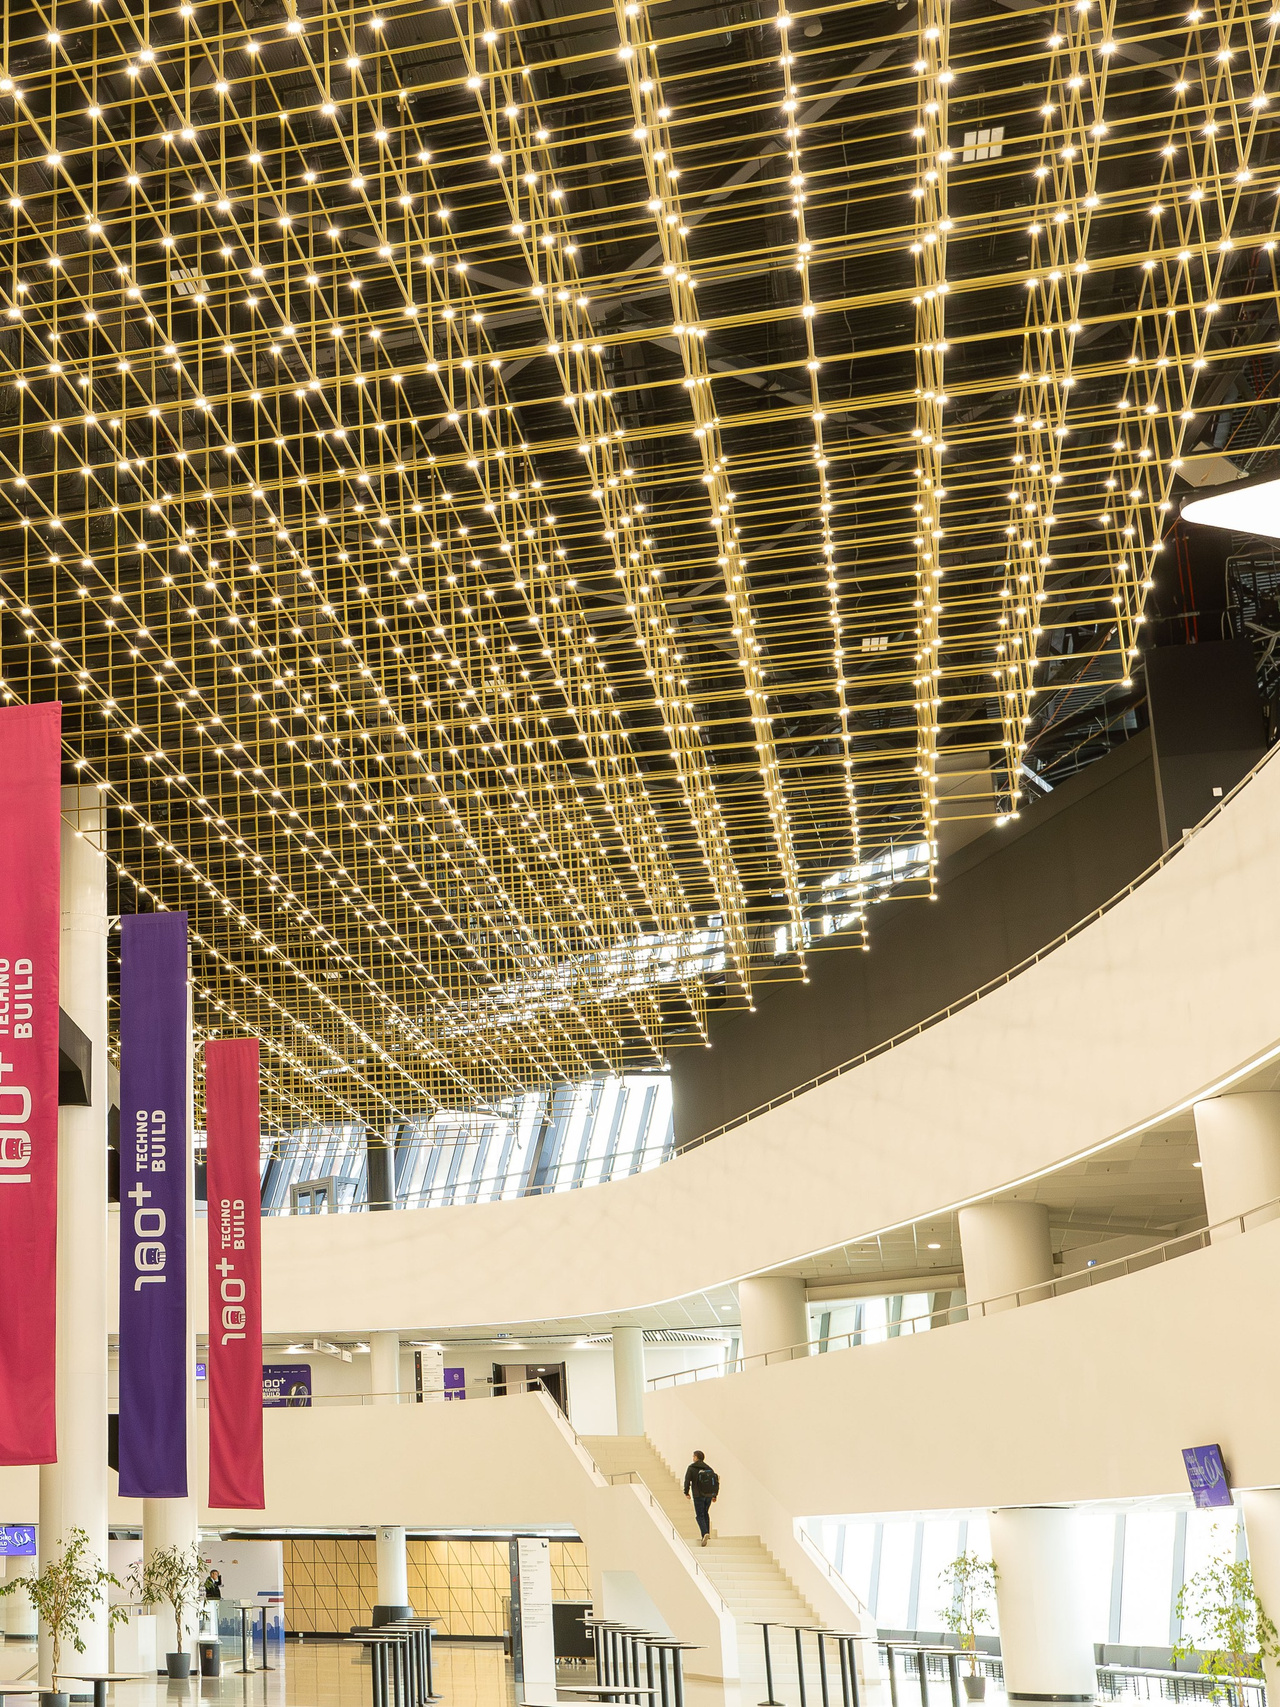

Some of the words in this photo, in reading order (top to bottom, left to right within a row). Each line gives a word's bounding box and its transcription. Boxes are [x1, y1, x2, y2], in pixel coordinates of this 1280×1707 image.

[13, 958, 33, 1039] BUILD
[136, 1109, 149, 1173] TECHNO
[151, 1109, 166, 1172] BUILD
[127, 1181, 167, 1292] 100+
[220, 1199, 231, 1250] TECHNO
[233, 1199, 245, 1250] BUILD
[215, 1257, 246, 1346] 100+
